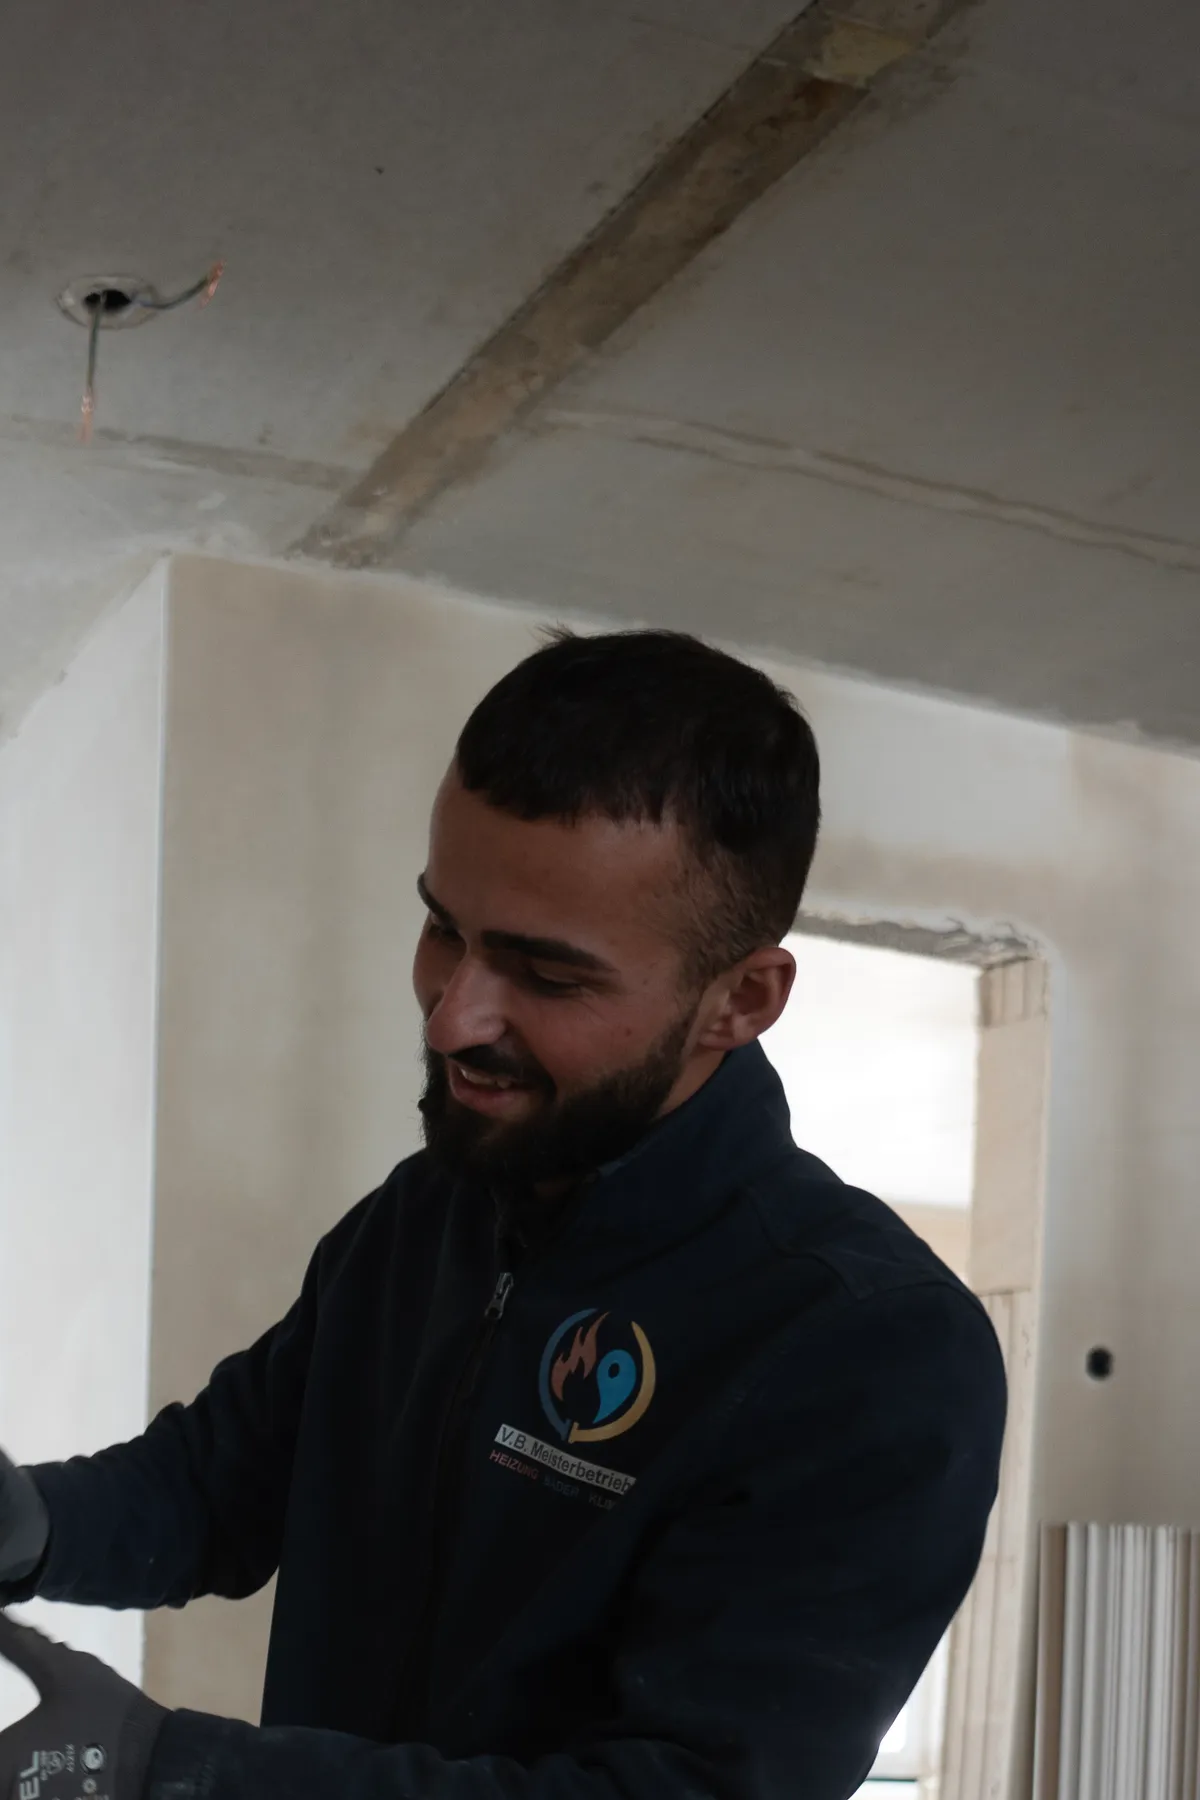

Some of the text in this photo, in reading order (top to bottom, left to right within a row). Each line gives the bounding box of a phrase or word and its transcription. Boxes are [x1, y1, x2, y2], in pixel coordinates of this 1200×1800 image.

[489, 1450, 539, 1480] HEIZUNG
[502, 1427, 633, 1494] V.B. Meisterbetrieb
